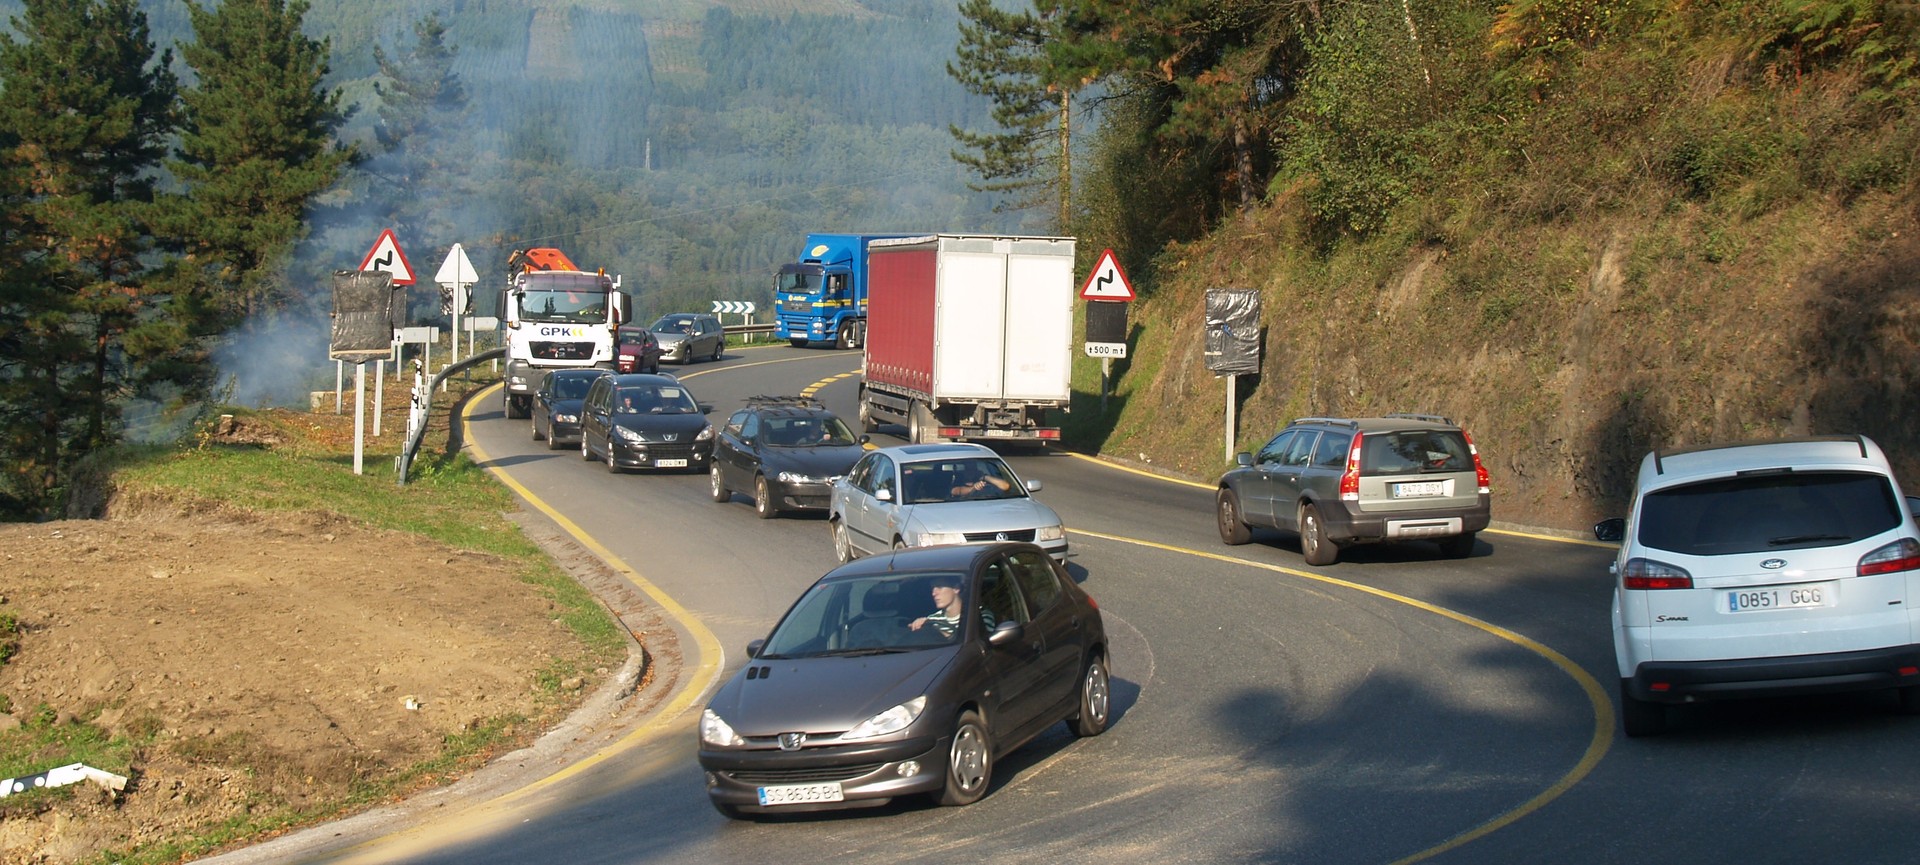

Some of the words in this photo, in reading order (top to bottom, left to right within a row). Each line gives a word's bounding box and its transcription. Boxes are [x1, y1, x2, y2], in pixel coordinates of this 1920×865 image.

[540, 327, 571, 337] GPK
[1094, 346, 1110, 354] 500
[1739, 591, 1779, 608] 0851
[1790, 588, 1821, 604] GCG
[767, 789, 784, 801] SS
[786, 787, 820, 801] 8635
[822, 785, 839, 799] BH
